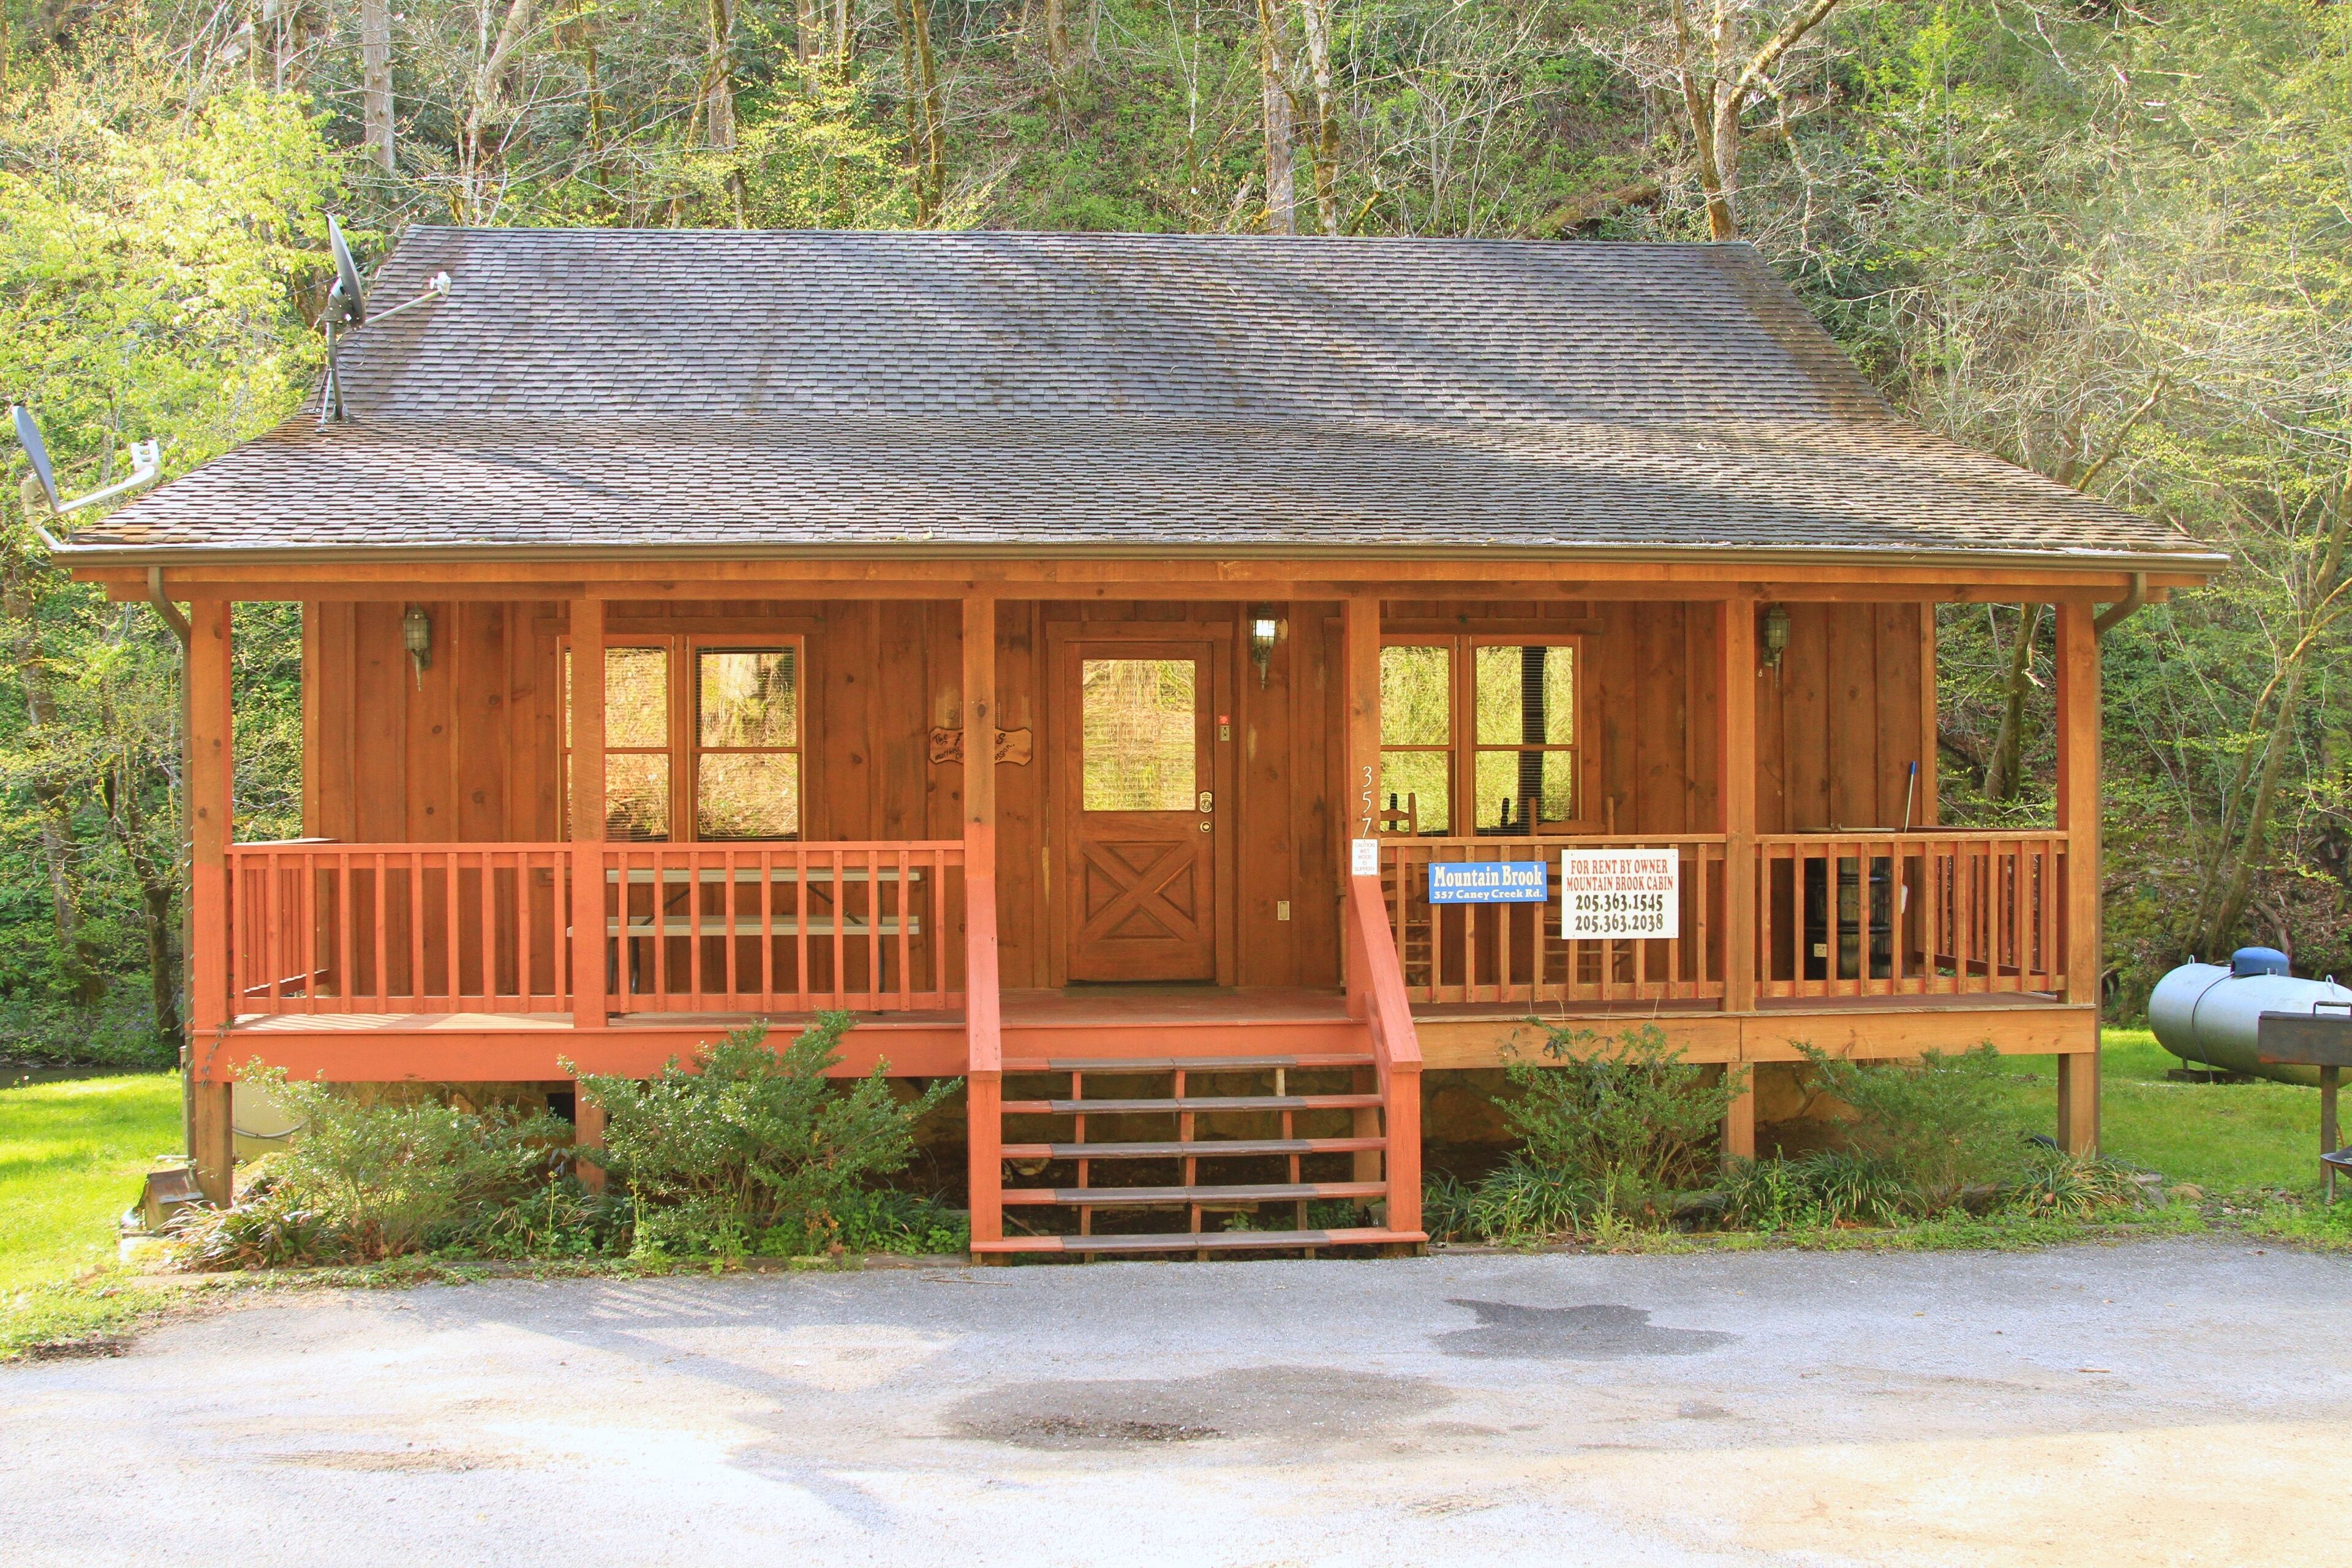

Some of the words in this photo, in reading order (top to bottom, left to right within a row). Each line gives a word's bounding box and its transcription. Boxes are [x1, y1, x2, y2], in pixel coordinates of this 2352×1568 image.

[1362, 766, 1373, 839] 357
[1434, 866, 1499, 887] Mountain
[1502, 865, 1542, 886] Brook
[1571, 860, 1589, 874] FOR
[1593, 860, 1617, 874] RENT
[1620, 859, 1632, 874] BY
[1634, 859, 1668, 874] OWNER
[1567, 877, 1613, 891] MOUNTAIN
[1616, 876, 1645, 891] BROOK
[1646, 876, 1673, 891] CABIN
[1456, 890, 1490, 900] Caney
[1491, 889, 1523, 899] Creek
[1525, 889, 1543, 898] Rd.
[1575, 892, 1663, 912] 205.363.1545
[1575, 913, 1663, 933] 205.363.2038
